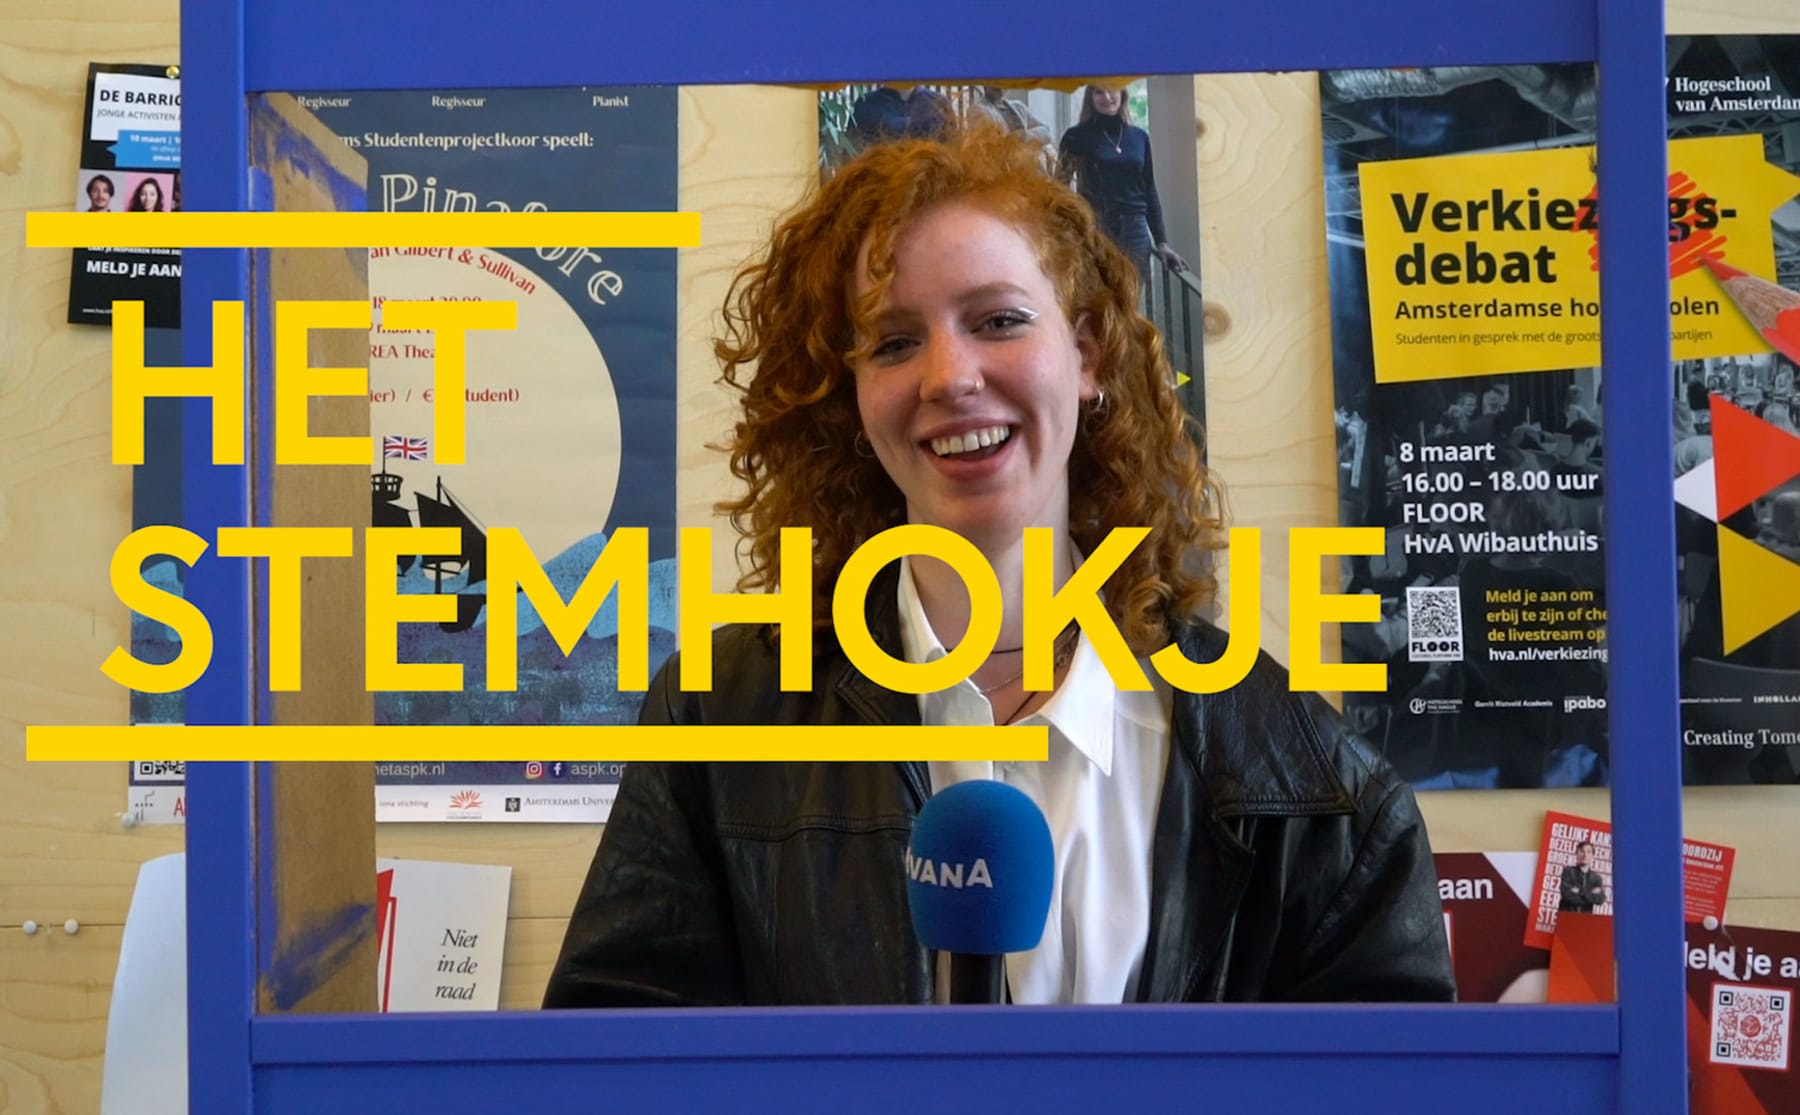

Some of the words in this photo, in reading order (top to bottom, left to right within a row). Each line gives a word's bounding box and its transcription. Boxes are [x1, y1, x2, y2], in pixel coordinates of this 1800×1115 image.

[100, 89, 120, 102] DE
[1675, 76, 1772, 96] Hogeschool
[297, 96, 351, 110] Regisseur
[432, 95, 487, 110] Regisseur
[593, 95, 629, 107] Pianist
[1676, 99, 1707, 112] van
[97, 108, 125, 118] JONGE
[128, 111, 175, 121] ACTIVISTEN
[364, 132, 539, 150] Studentenprojectkoor
[543, 132, 594, 150] speelt:
[86, 260, 128, 275] MELD
[130, 262, 146, 278] JE
[149, 263, 182, 277] AAN
[457, 248, 473, 264] &
[478, 254, 536, 295] Sullivan
[1395, 241, 1557, 286] debat
[1395, 298, 1562, 319] Amsterdamse
[1396, 333, 1456, 345] Studenten
[1459, 331, 1470, 343] in
[1473, 330, 1519, 346] gesprek
[1522, 331, 1545, 343] met
[1548, 330, 1563, 342] de
[1400, 443, 1414, 462] 8
[1421, 442, 1496, 462] maart
[1402, 472, 1463, 492] 16.00
[1488, 471, 1550, 490] 18.00
[1556, 472, 1599, 491] uur
[1403, 503, 1486, 523] FLOOR
[1405, 533, 1454, 553] HvA
[1459, 530, 1599, 552] Wibauthuis
[1485, 590, 1520, 602] Meld
[1523, 589, 1537, 606] je
[1540, 591, 1567, 602] aan
[1570, 590, 1594, 602] om
[1486, 608, 1519, 625] erbij
[1522, 610, 1537, 622] te
[1539, 608, 1565, 625] zijn
[1567, 607, 1583, 621] of
[1488, 628, 1505, 641] de
[1508, 627, 1584, 641] livestream
[1586, 628, 1606, 644] op
[1411, 640, 1460, 653] FLOOR
[1683, 729, 1754, 749] Creating
[1438, 878, 1494, 900] aan
[441, 928, 478, 948] Niet
[437, 954, 455, 973] in
[457, 956, 478, 975] de
[1742, 946, 1772, 981] je
[435, 982, 476, 1001] raad
